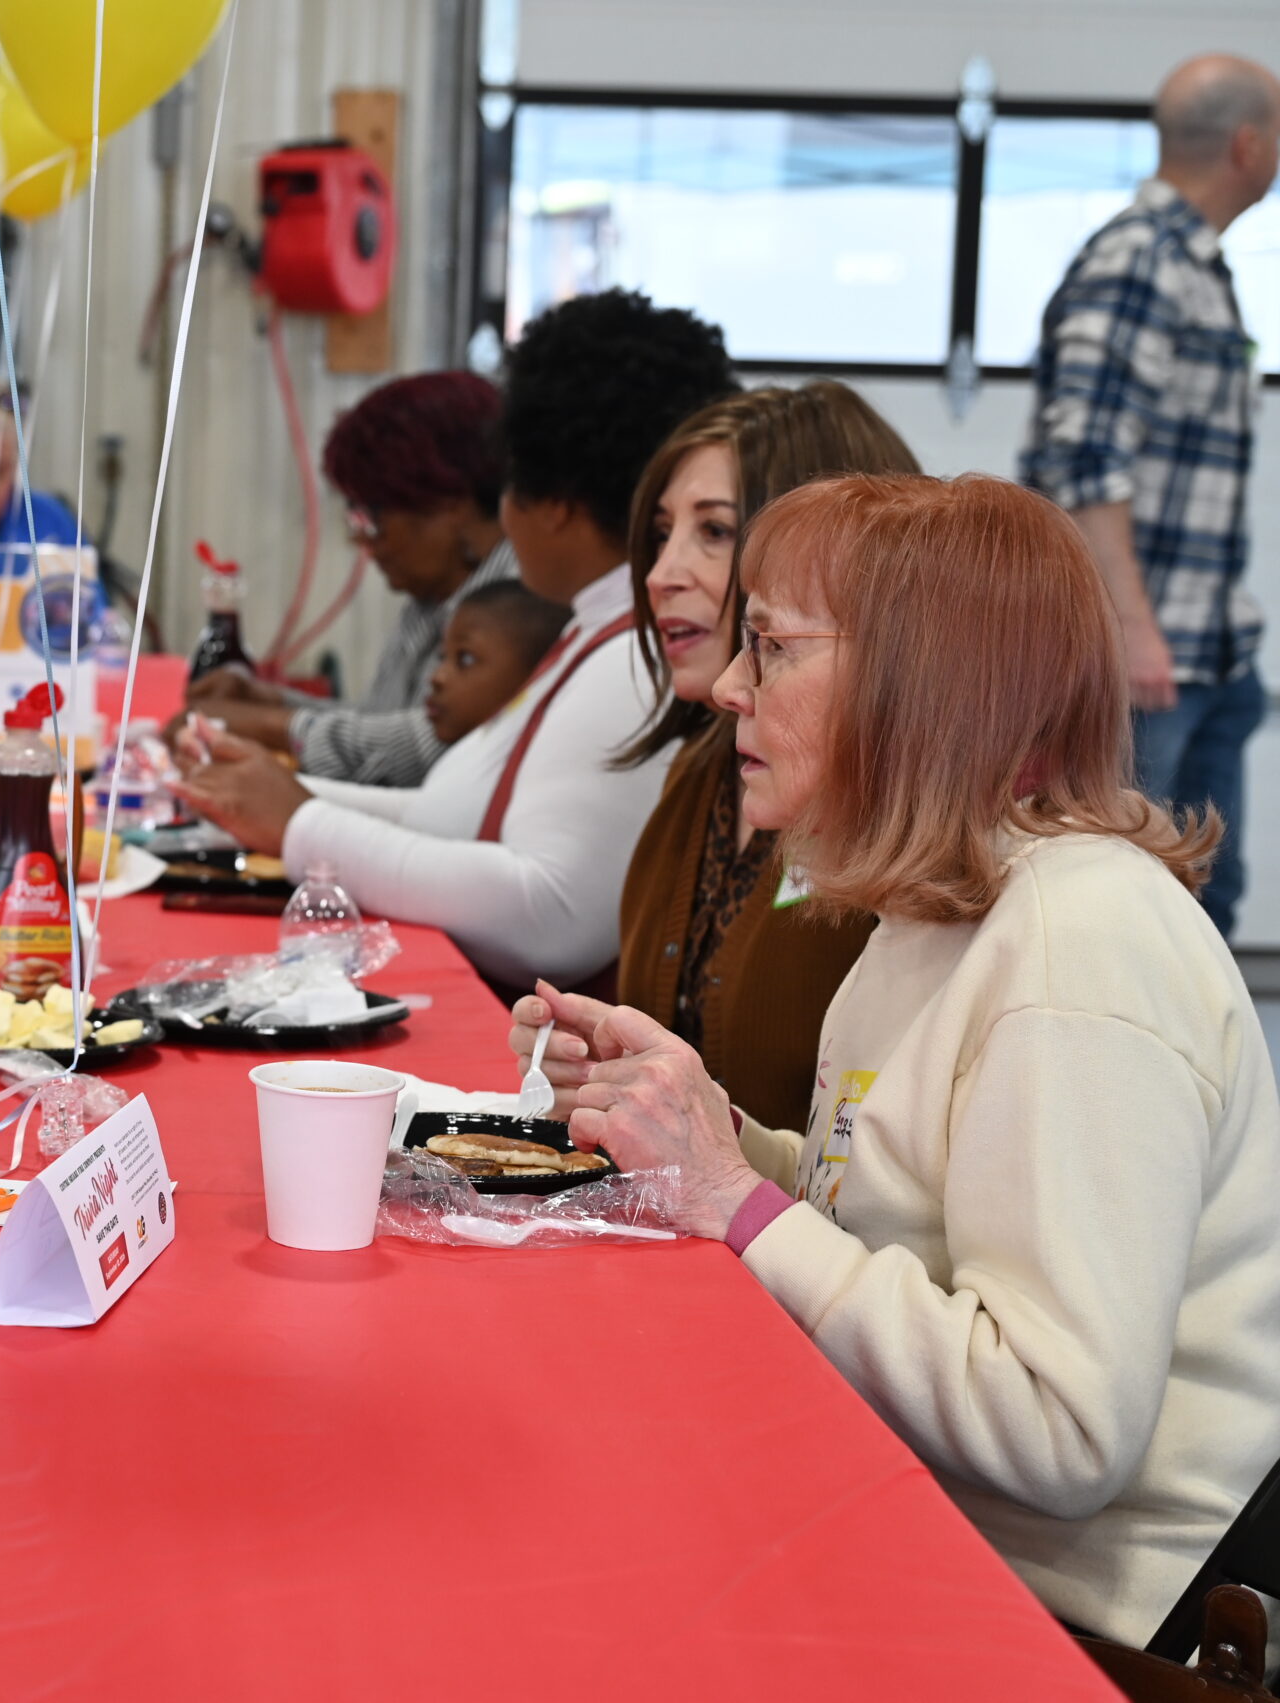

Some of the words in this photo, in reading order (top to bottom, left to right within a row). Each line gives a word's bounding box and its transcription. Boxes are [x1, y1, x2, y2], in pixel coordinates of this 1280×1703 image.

[16, 880, 57, 896] Pearl
[74, 1194, 102, 1241] Trivia
[91, 1157, 119, 1209] Night
[96, 1229, 106, 1244] SAVE
[103, 1221, 112, 1236] THE
[109, 1214, 119, 1230] DATE
